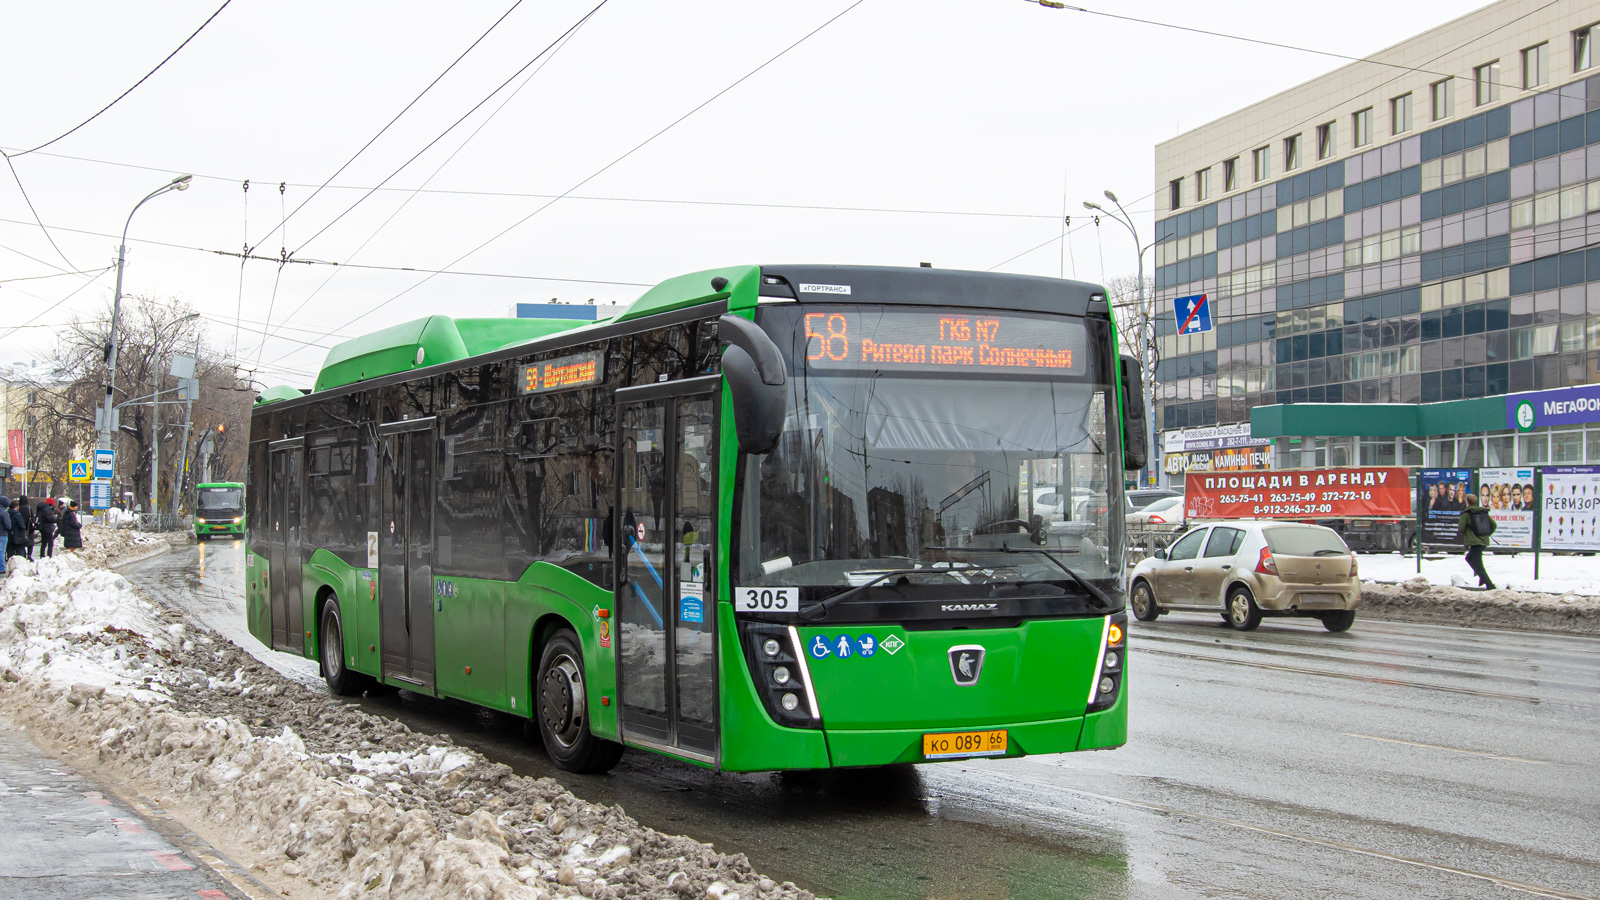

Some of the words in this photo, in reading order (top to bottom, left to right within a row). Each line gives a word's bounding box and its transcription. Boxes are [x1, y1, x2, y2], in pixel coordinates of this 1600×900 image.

[804, 285, 847, 293] «ГОРТРАНС»
[804, 312, 849, 361] 58
[939, 317, 971, 341] ГКБ
[976, 319, 1000, 342] N7
[861, 338, 926, 363] Ритейл
[931, 345, 974, 365] парк
[978, 342, 1072, 368] Солнечный
[1184, 429, 1212, 439] КРОВЕЛЬНЫЕ
[1217, 425, 1242, 436] ФАСАДНЫЕ
[1166, 456, 1190, 472] АВТО
[1215, 453, 1248, 468] КАМИНЫ
[1249, 452, 1270, 466] ПЕЧИ
[1205, 474, 1293, 489] ПЛОЩАДИ
[1300, 475, 1309, 487] В
[1316, 471, 1388, 486] АРЕНДУ
[1220, 493, 1264, 504] 263-75-41
[1270, 492, 1316, 503] 263-75-49
[1322, 491, 1371, 501] 372-72-16
[1545, 497, 1600, 510] РЕВИЗОР
[1253, 503, 1332, 514] 8-912-246-37-00
[746, 589, 789, 610] 305
[941, 603, 999, 612] KAMAZ
[885, 639, 899, 648] КПГ
[931, 739, 949, 752] КО
[955, 734, 982, 750] 089
[989, 732, 1003, 744] 66
